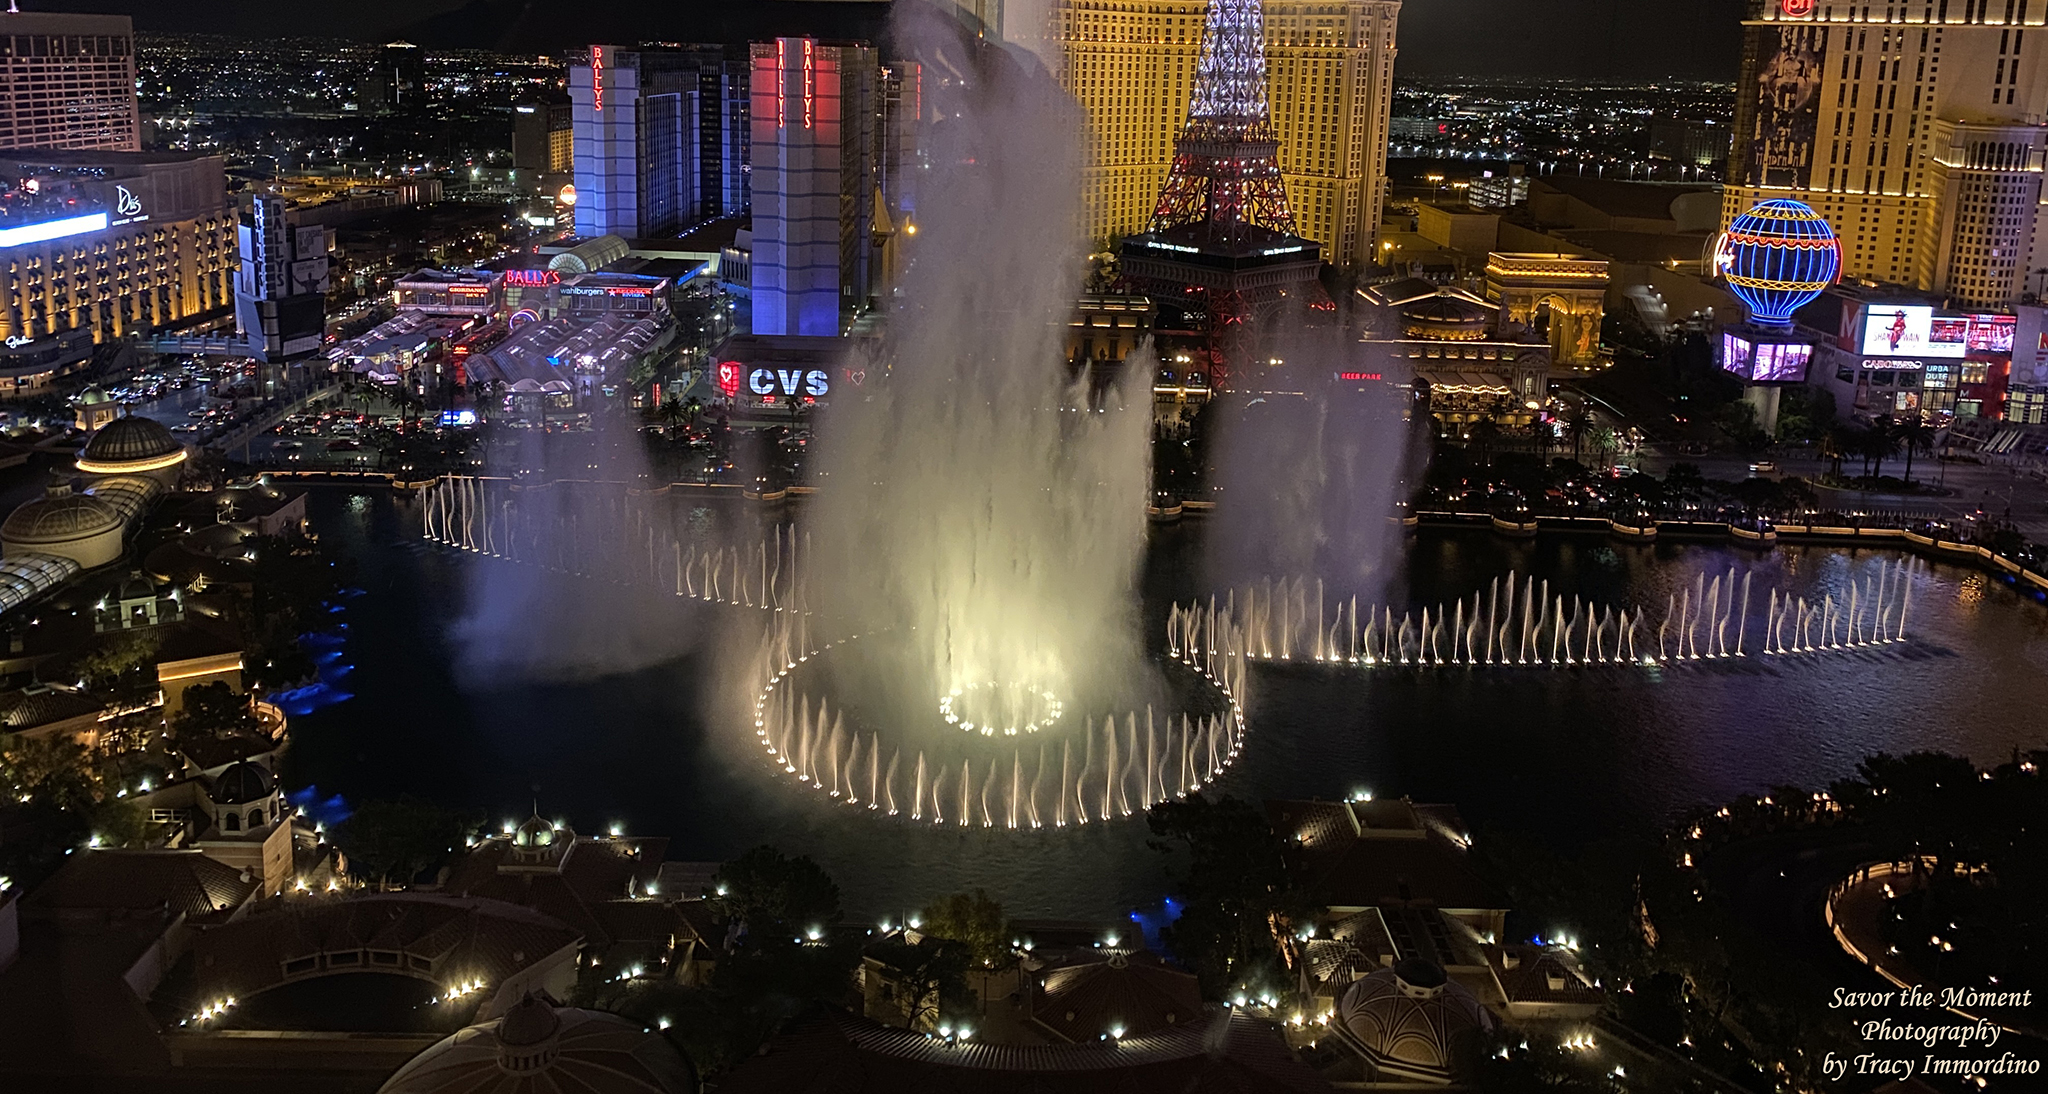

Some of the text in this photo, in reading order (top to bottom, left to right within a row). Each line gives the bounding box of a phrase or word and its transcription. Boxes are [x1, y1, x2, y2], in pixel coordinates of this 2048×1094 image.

[593, 46, 604, 111] BALLYS
[803, 39, 812, 129] BALLYS
[272, 203, 285, 287] BALLYS
[506, 269, 560, 284] BALLY'S
[560, 287, 605, 297] wahlburgers
[1840, 304, 1861, 341] M
[749, 368, 829, 396] CVS
[1361, 373, 1382, 381] PARK
